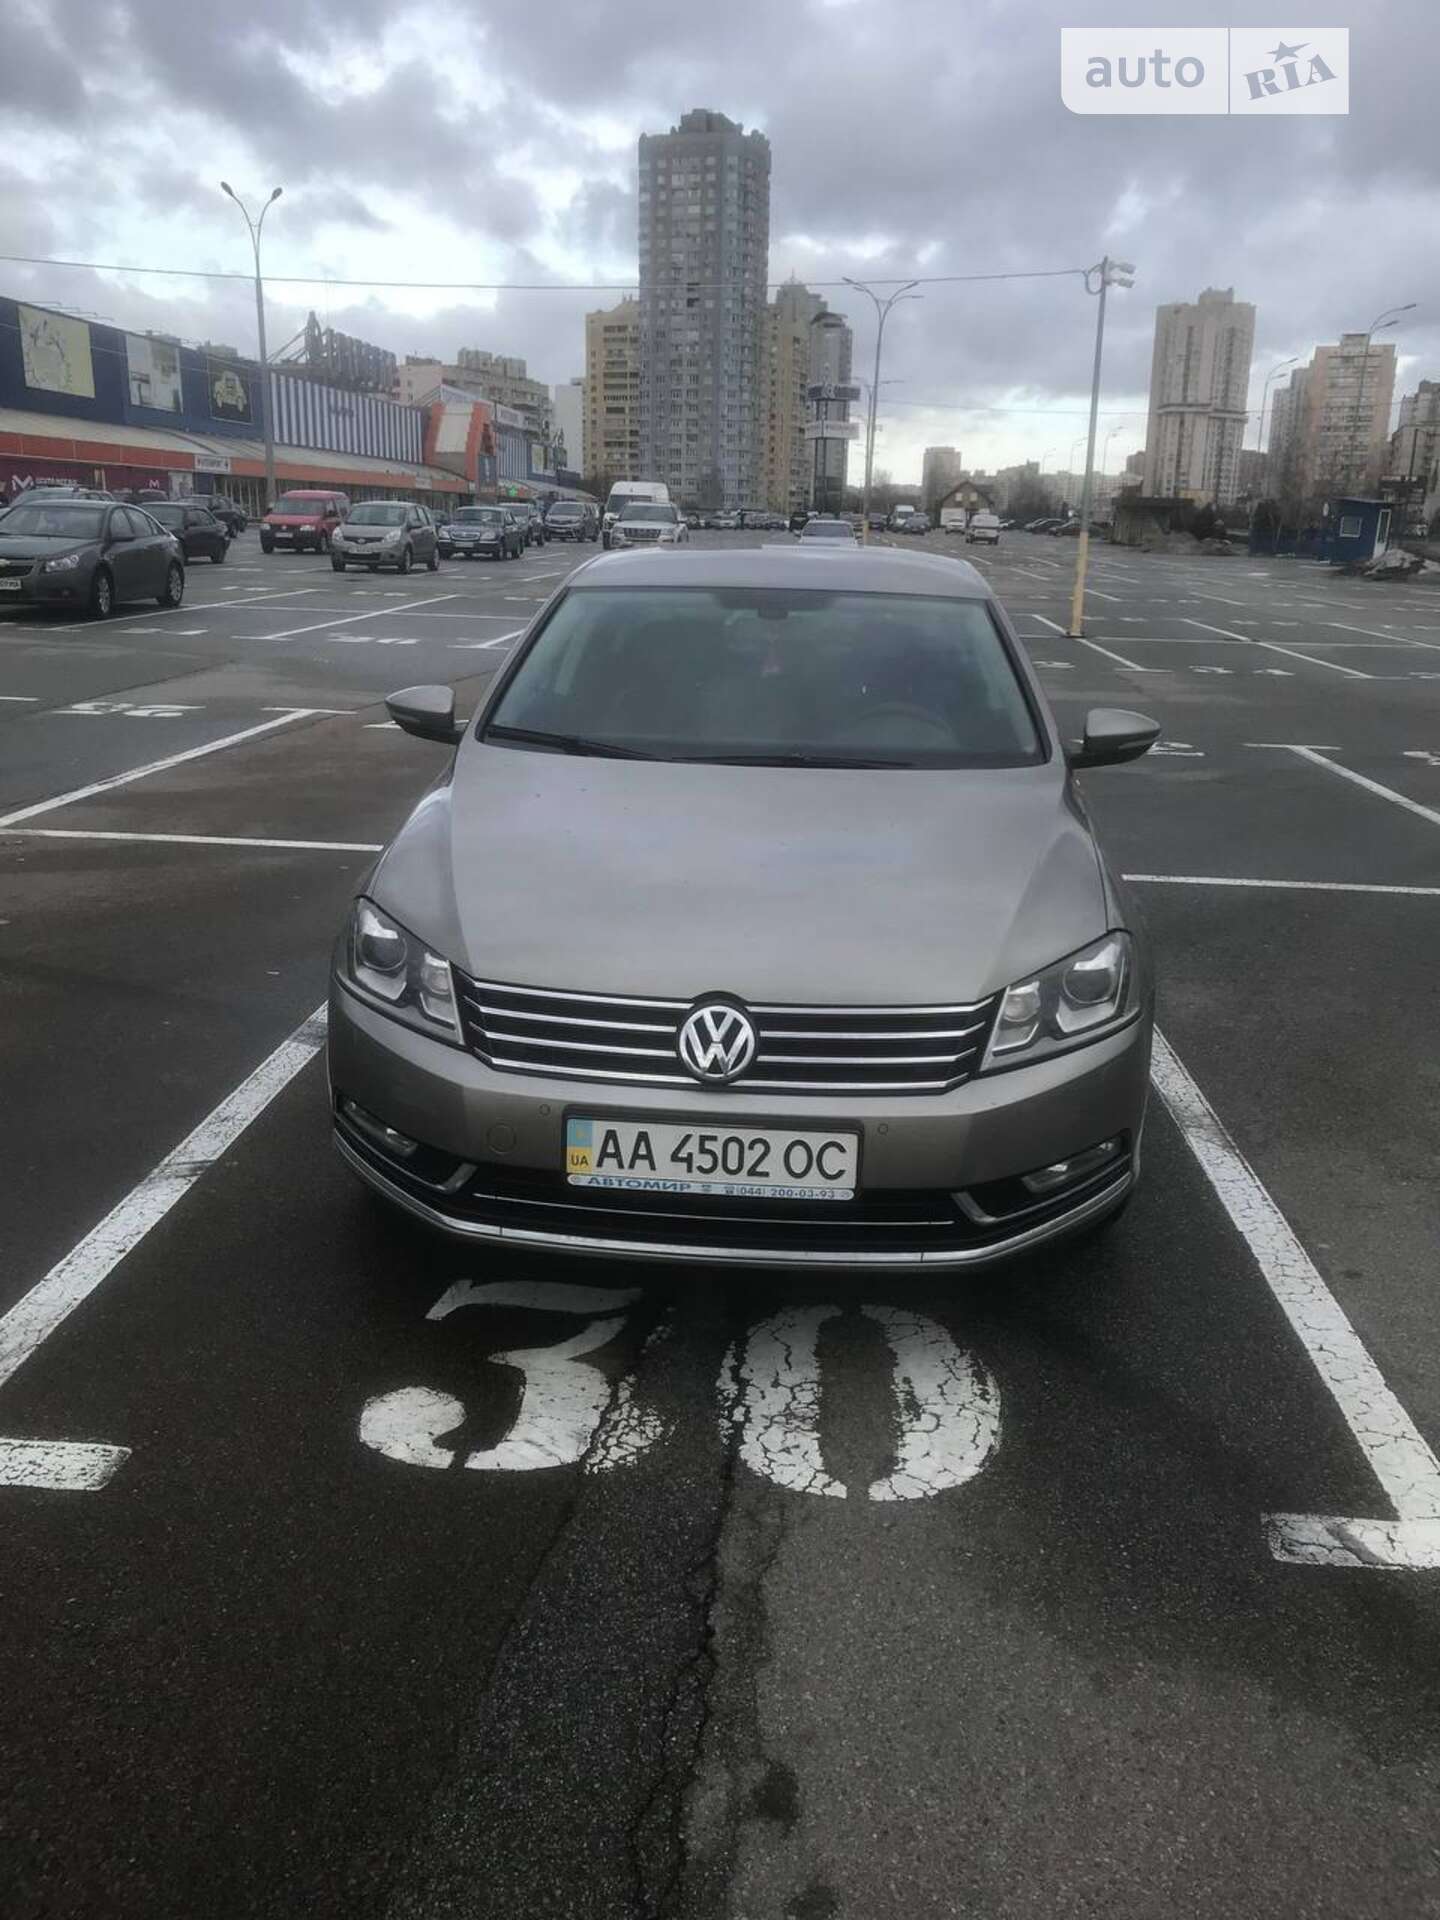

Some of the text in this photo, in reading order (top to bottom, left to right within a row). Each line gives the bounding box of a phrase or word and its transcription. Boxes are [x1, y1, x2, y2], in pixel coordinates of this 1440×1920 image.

[571, 1154, 589, 1166] UA
[596, 1129, 847, 1181] AA 4502 OC
[587, 1177, 692, 1192] АВТОМИР
